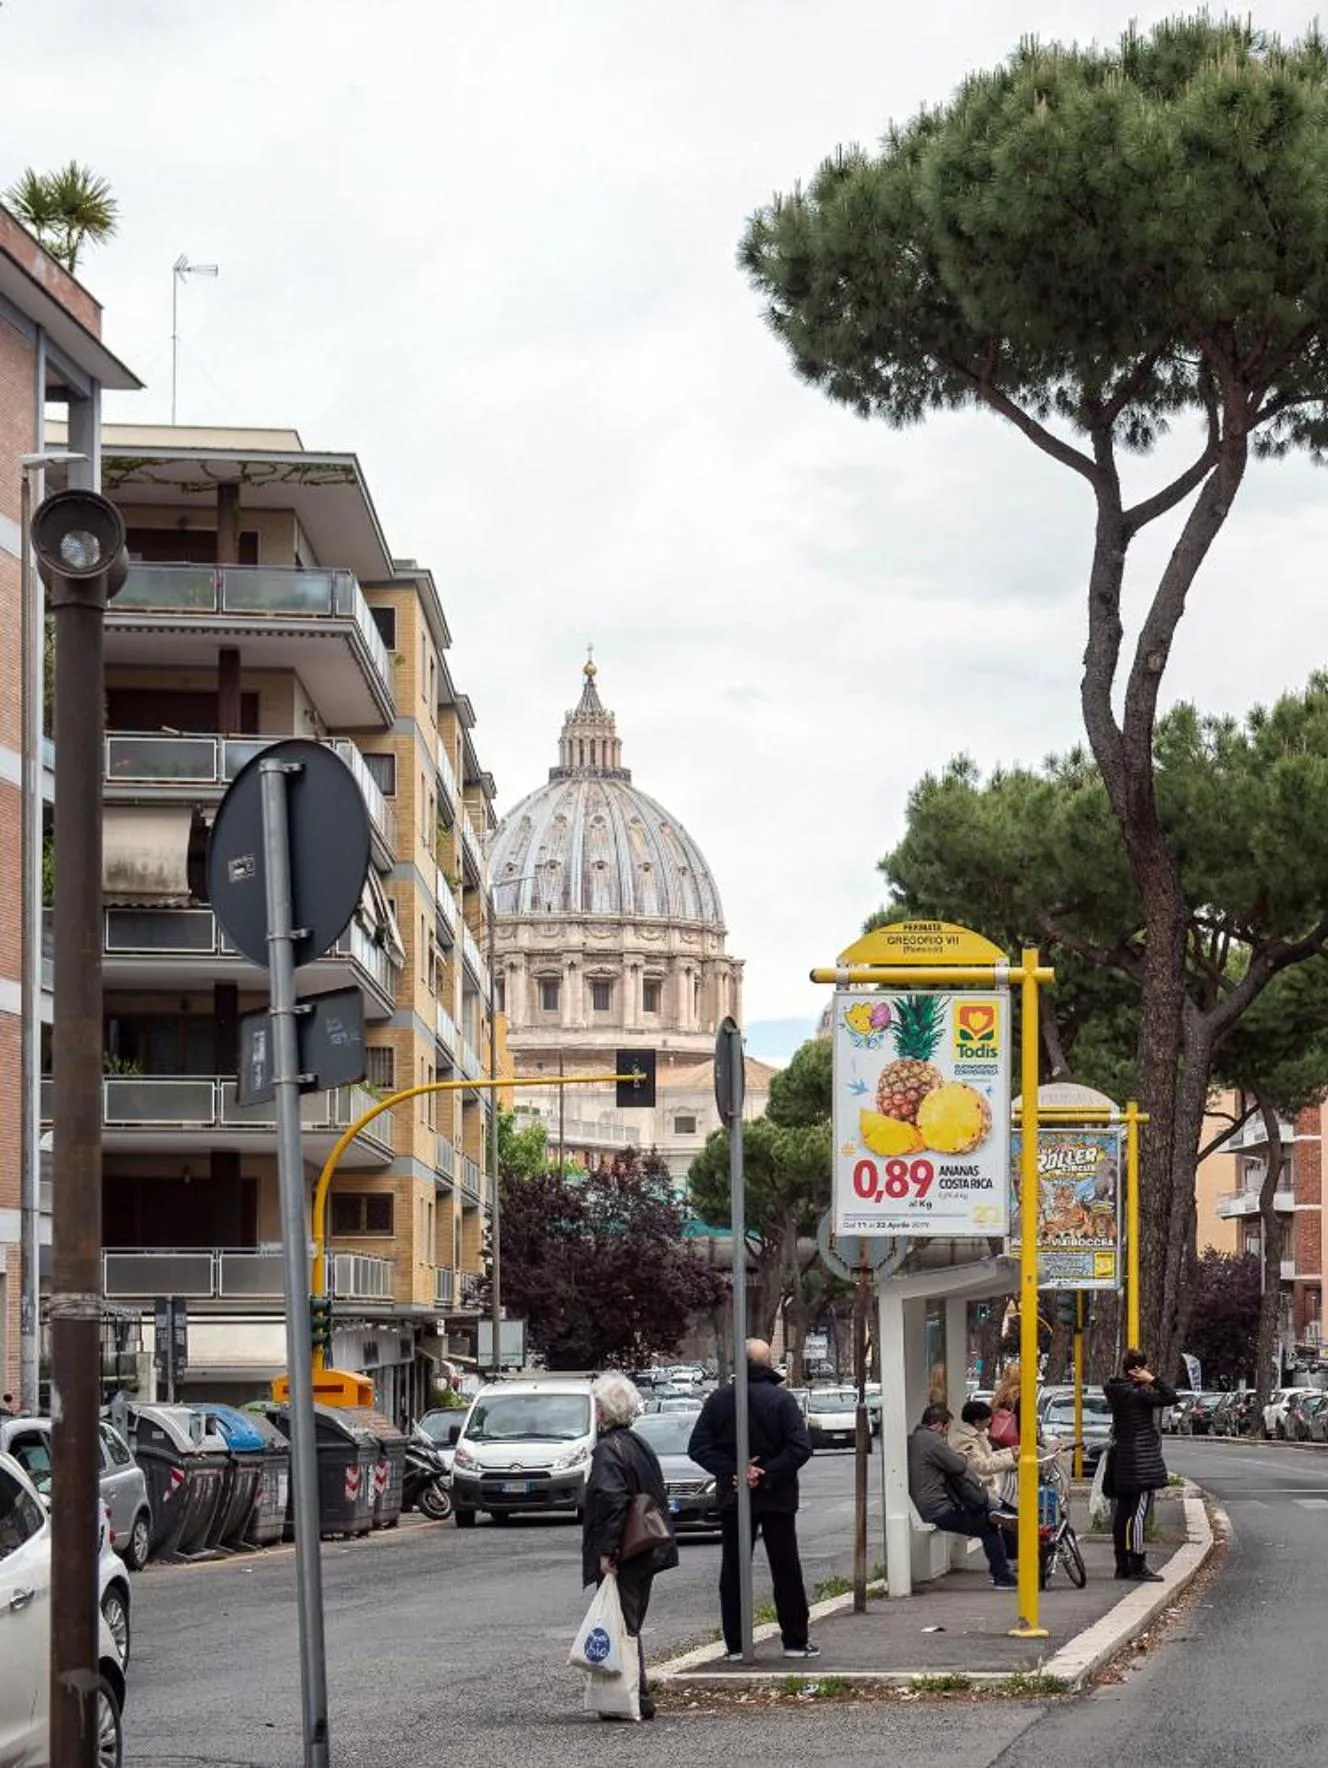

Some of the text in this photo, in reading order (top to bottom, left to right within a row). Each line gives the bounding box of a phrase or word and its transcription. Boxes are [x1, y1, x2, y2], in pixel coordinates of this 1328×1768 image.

[887, 935, 959, 945] GREGORIO VII
[956, 1044, 998, 1058] Todis
[938, 1165, 979, 1177] ANANAS
[853, 1158, 934, 1203] 0,89
[938, 1178, 993, 1190] COSTA RICA
[919, 1200, 932, 1210] Kg
